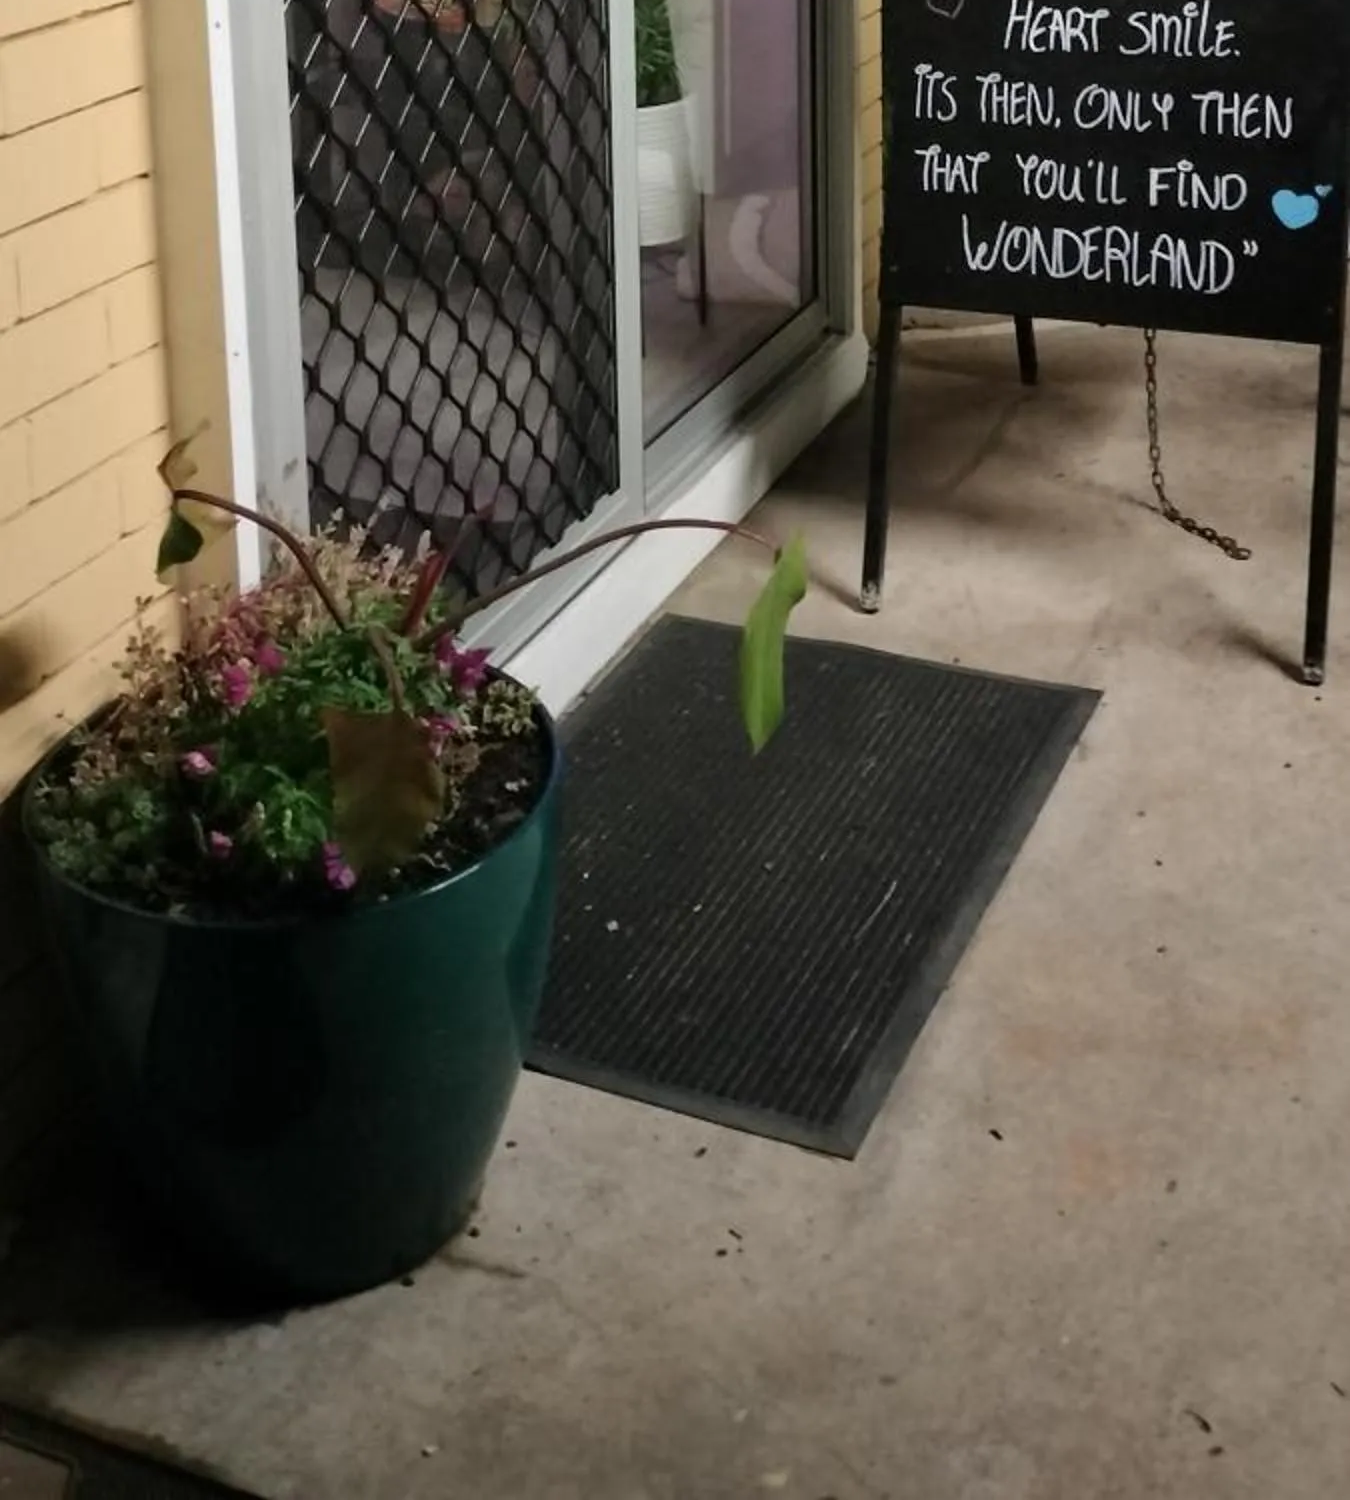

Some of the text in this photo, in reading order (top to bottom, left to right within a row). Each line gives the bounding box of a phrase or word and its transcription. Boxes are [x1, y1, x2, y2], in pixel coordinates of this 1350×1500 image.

[1074, 84, 1175, 133] ONLY
[1191, 91, 1294, 139] THEN
[915, 144, 991, 194] THAT
[1016, 153, 1126, 204] YOU'LL
